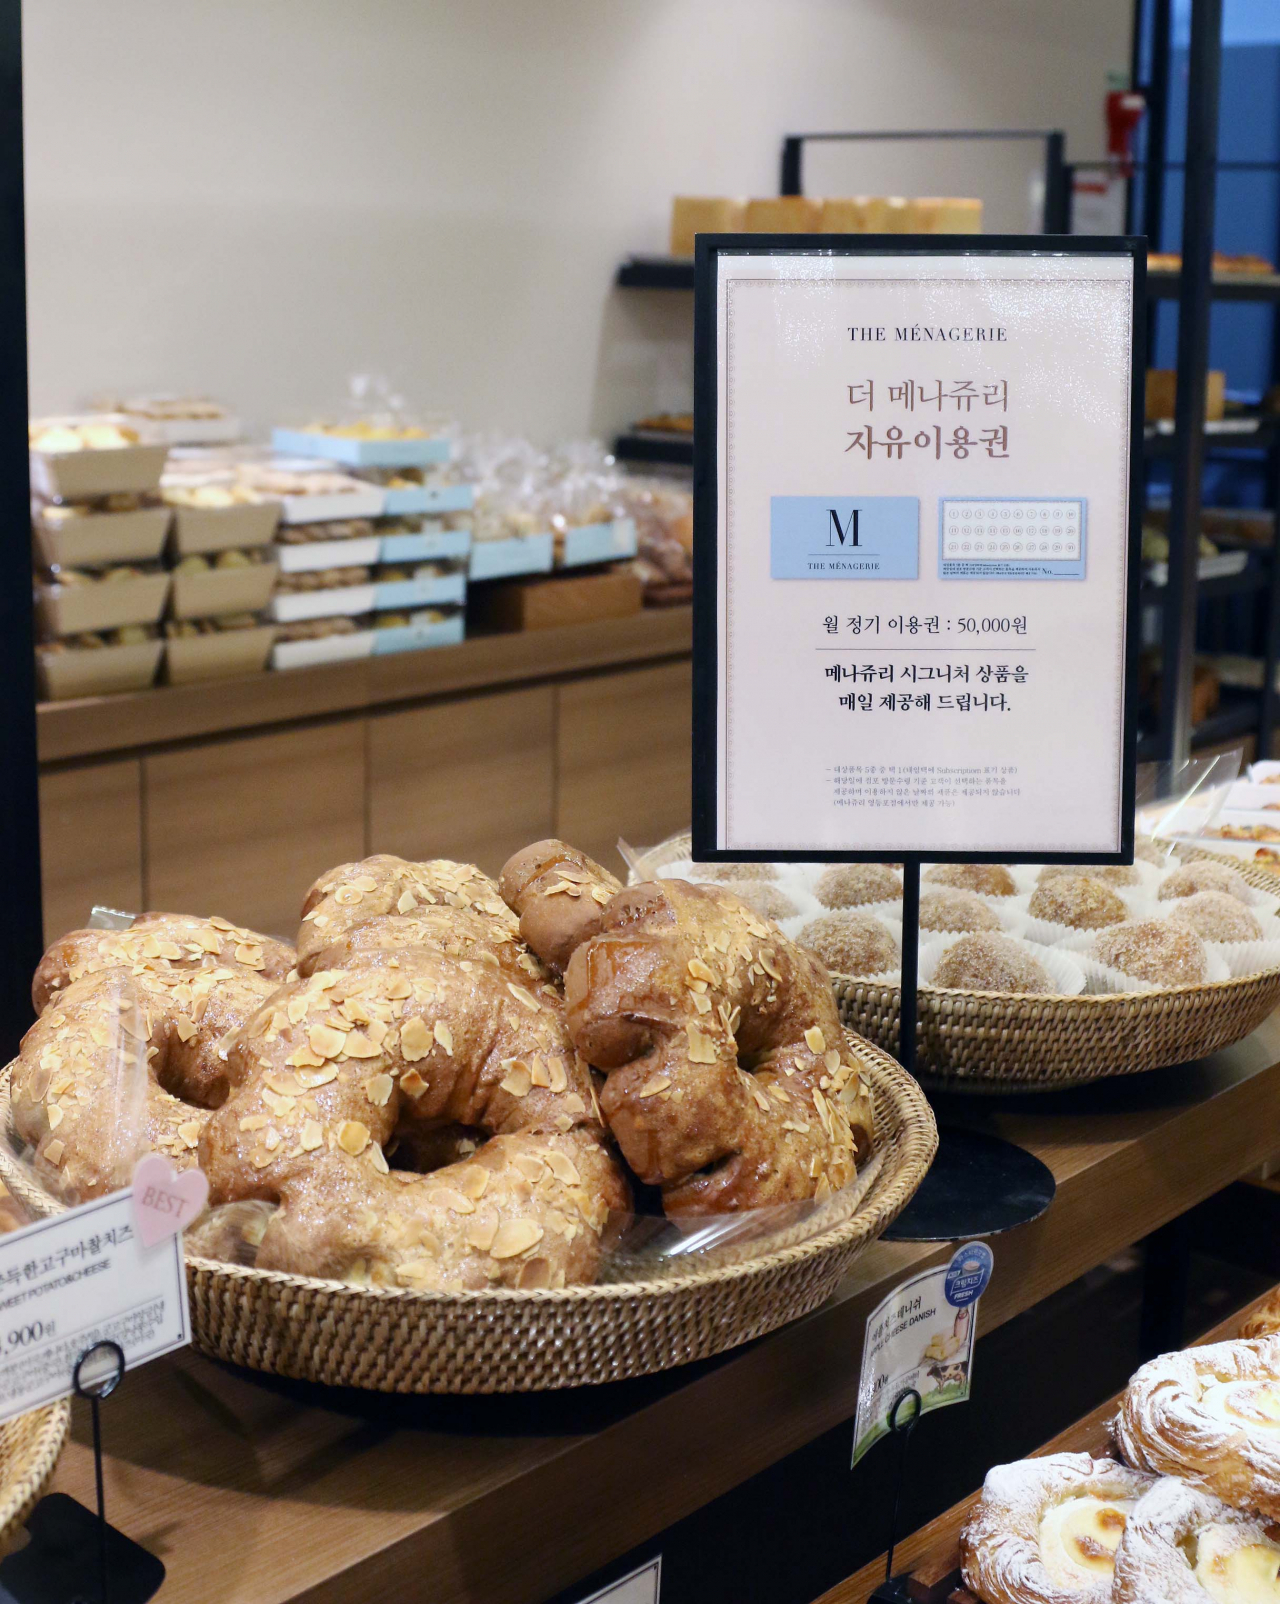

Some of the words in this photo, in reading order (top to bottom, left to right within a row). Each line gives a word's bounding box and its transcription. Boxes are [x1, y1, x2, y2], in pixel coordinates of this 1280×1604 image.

[848, 327, 886, 342] THE
[894, 323, 1008, 342] MÉNAGERIE
[847, 379, 875, 412] 더
[887, 379, 1009, 412] 메나쥬리
[844, 424, 1010, 461] 자유이용권
[825, 509, 863, 547] M
[807, 562, 827, 570] THE
[829, 561, 881, 570] MÉNAGERIE
[1042, 567, 1053, 575] No.
[822, 615, 839, 635] 월
[846, 615, 880, 635] 정기
[888, 615, 940, 635] 이용권
[957, 615, 1028, 635] 50,000원
[824, 664, 895, 684] 메나쥬리
[900, 664, 970, 684] 시그니처
[975, 664, 1029, 684] 상품을
[839, 692, 873, 712] 매일
[878, 692, 931, 712] 제공해
[936, 692, 1012, 712] 드립니다.
[142, 1186, 189, 1219] BEST
[908, 1307, 937, 1327] DANISH
